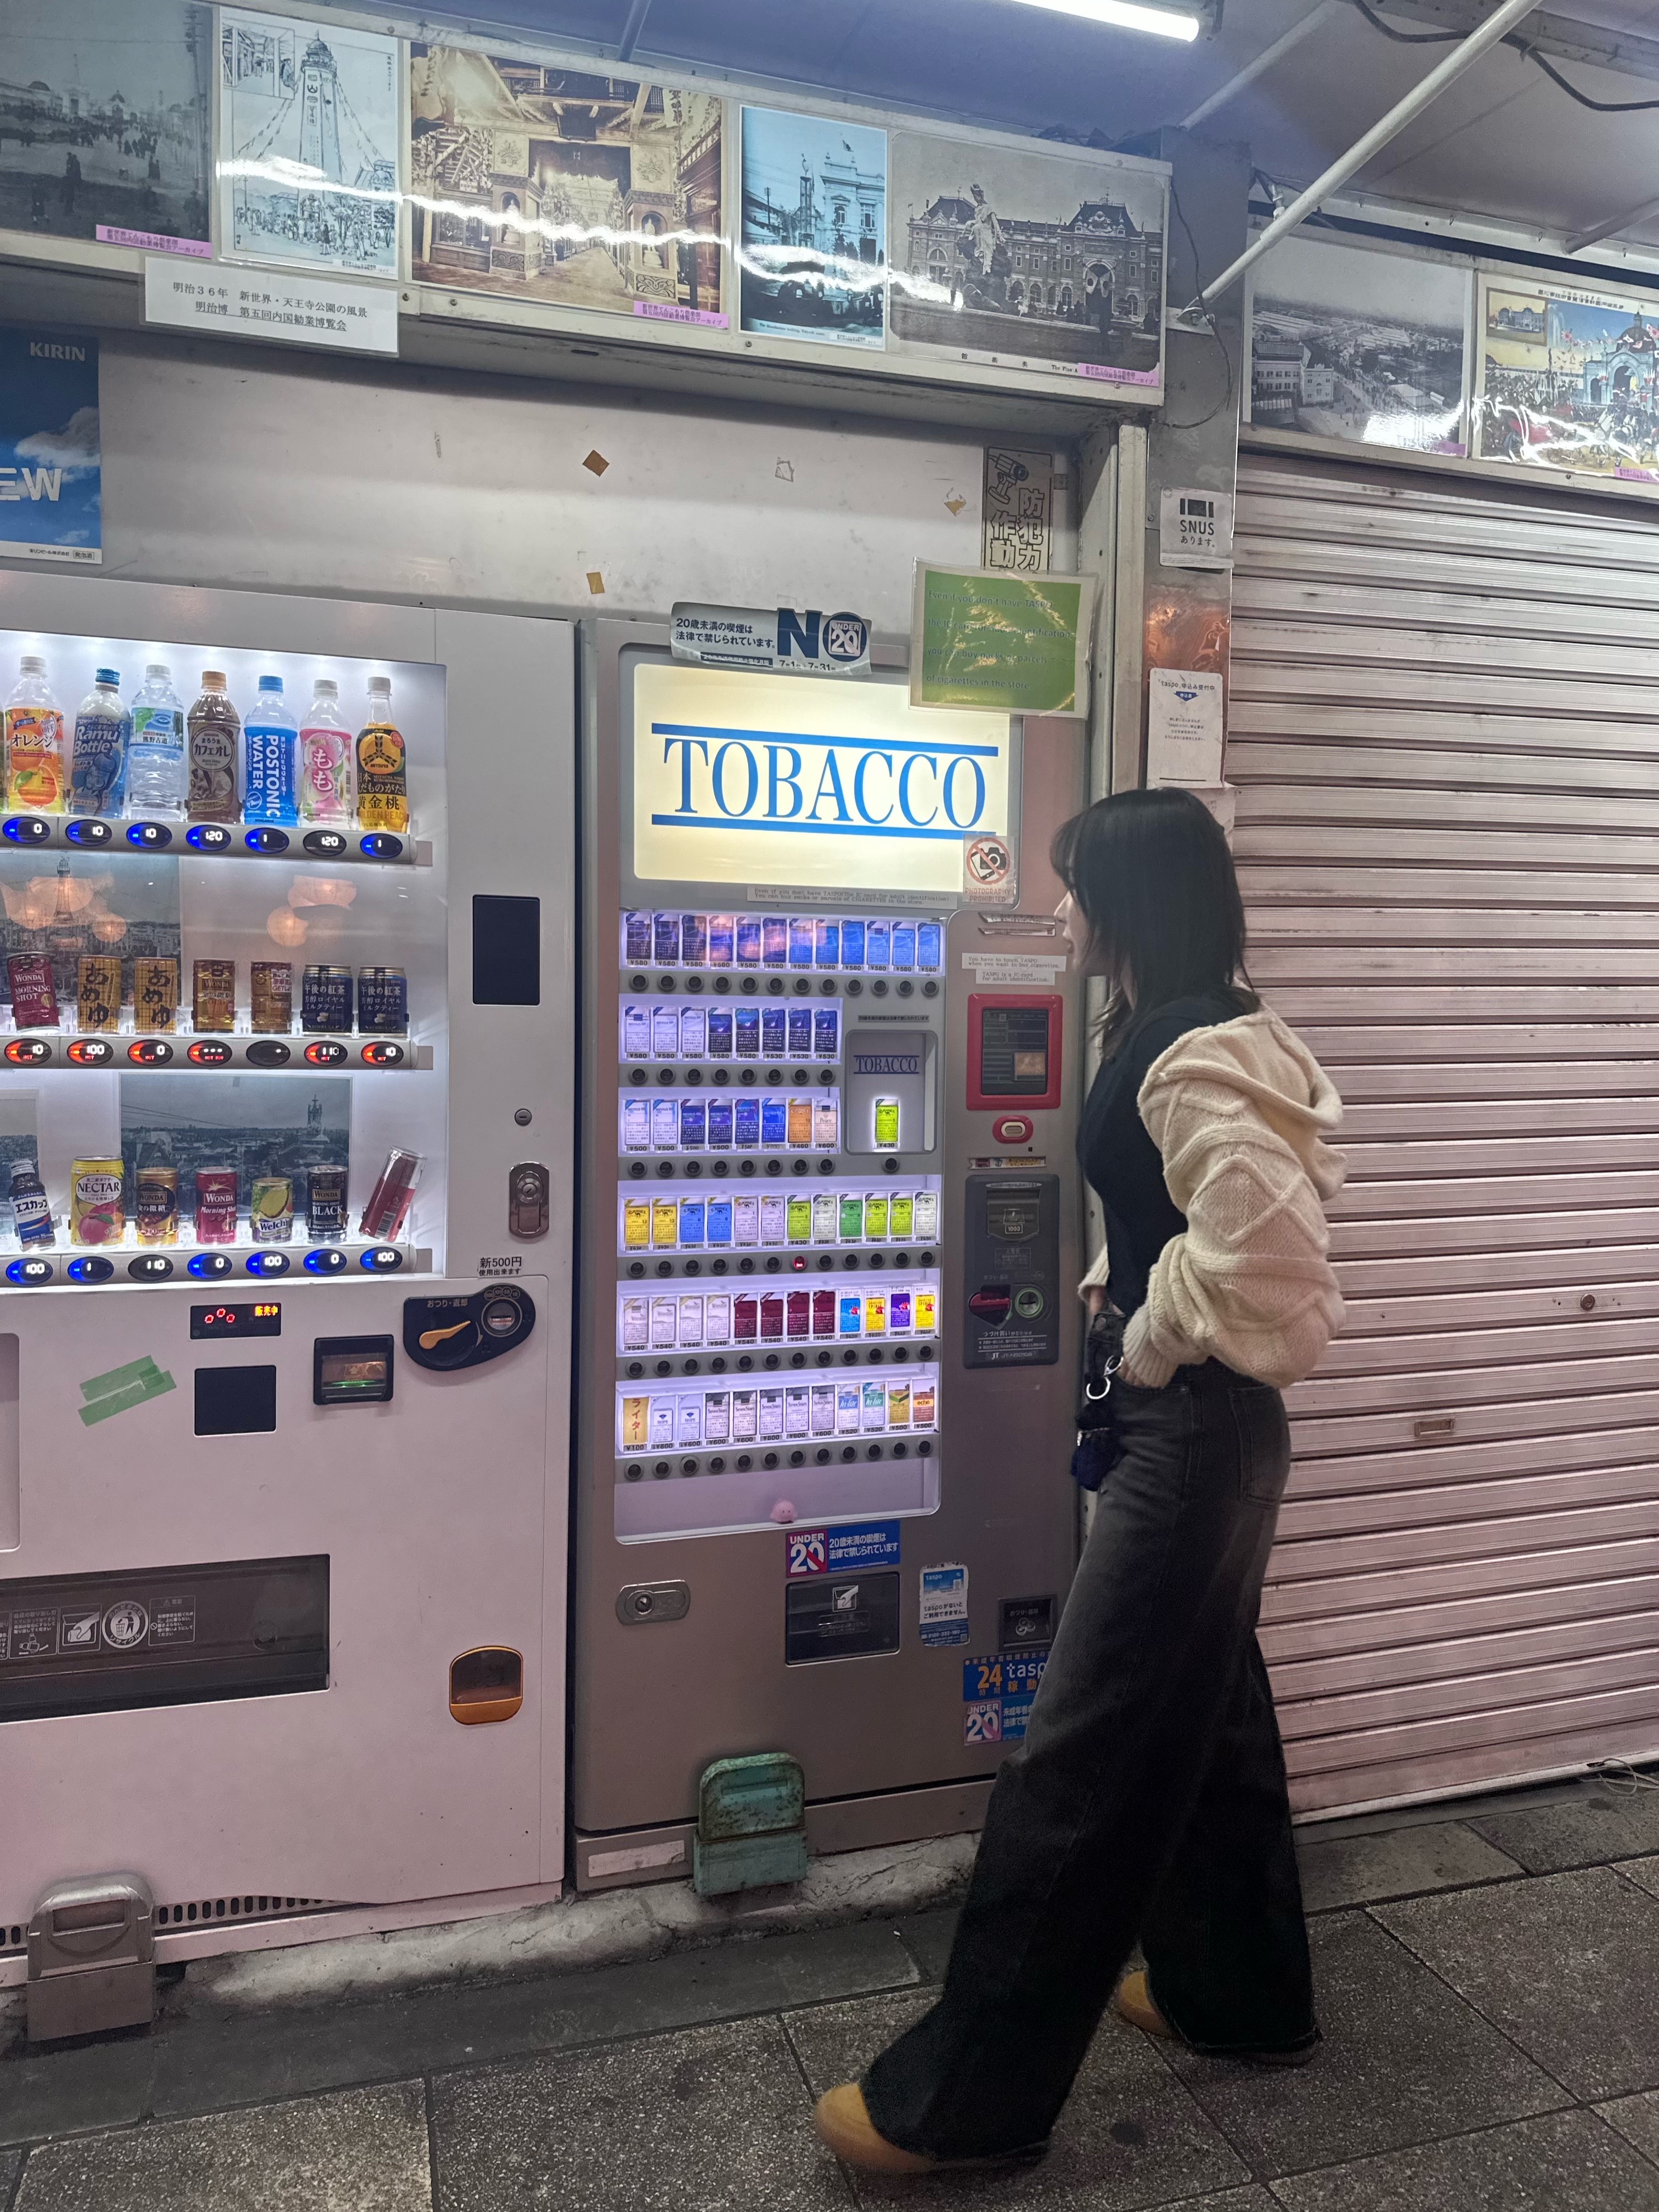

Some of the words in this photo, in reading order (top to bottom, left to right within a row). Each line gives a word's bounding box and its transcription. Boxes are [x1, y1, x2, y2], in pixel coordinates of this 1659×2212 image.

[239, 290, 368, 318] 新世界・天王寺公園の風景
[196, 301, 228, 315] 明治博
[239, 306, 347, 331] 第五回内国勧業博覧会
[30, 341, 86, 362] KIRIN
[1180, 519, 1215, 536] SNUS
[1180, 536, 1216, 548] あります。
[928, 590, 947, 600] Even
[958, 595, 974, 604] you
[977, 596, 1000, 605] don't
[1001, 598, 1022, 607] have
[676, 618, 753, 635] 20歳未満の喫煙は
[831, 621, 860, 631] UNDER
[928, 618, 941, 627] the
[675, 630, 776, 649] 法律で禁じられています。
[831, 630, 860, 655] 20
[927, 647, 942, 657] you
[962, 649, 978, 659] buy
[1018, 654, 1048, 664] parcels
[937, 675, 979, 686] cigarettes
[991, 680, 1006, 688] the
[76, 725, 120, 741] Ramu
[11, 733, 54, 748] オレンジ
[73, 740, 111, 756] Bottle
[194, 743, 231, 757] カフェオレ
[252, 735, 263, 790] WATER
[266, 734, 281, 818] POSTONIC
[313, 748, 333, 791] もも
[663, 737, 986, 829] TOBACCO
[358, 795, 400, 810] 黄金桃
[964, 887, 1011, 896] PHOTOGRAPHY
[969, 895, 1006, 903] PROHIBITED
[15, 974, 43, 983] WONDA
[204, 980, 229, 988] WONDA
[15, 985, 51, 994] MORNING
[80, 963, 110, 1028] あめゆ
[304, 985, 345, 995] 午後の紅茶
[360, 986, 401, 996] 午後の紅茶
[16, 993, 38, 1003] SHOT
[141, 964, 171, 1029] あめゆ
[855, 1056, 918, 1073] TOBACCO
[77, 1181, 120, 1193] NECTAR
[139, 1193, 164, 1201] WONDA
[205, 1193, 234, 1203] WONDA
[15, 1199, 48, 1213] エスカップ
[200, 1206, 226, 1215] Morning
[312, 1206, 343, 1215] BLACK
[264, 1256, 282, 1266] 100
[378, 1252, 394, 1261] 100
[479, 1256, 522, 1269] 新500円
[26, 1263, 45, 1274] 100
[147, 1259, 165, 1270] 110
[479, 1268, 521, 1277] 使用出来ます
[427, 1298, 469, 1308] おつり・返却
[255, 1304, 279, 1316] 販売中
[991, 1352, 1000, 1360] JT
[631, 1399, 642, 1440] ライター
[789, 1532, 825, 1545] UNDER
[829, 1532, 887, 1548] 20歳未満の喫煙は
[790, 1541, 825, 1574] 20
[829, 1542, 899, 1560] 法律で禁じられています
[923, 1601, 963, 1611] taspoがないと
[923, 1610, 966, 1619] ご利用できません。
[110, 1633, 140, 1644] リサイクル
[977, 1664, 1003, 1690] 24
[1006, 1662, 1047, 1679] tasp
[966, 1711, 999, 1742] 20
